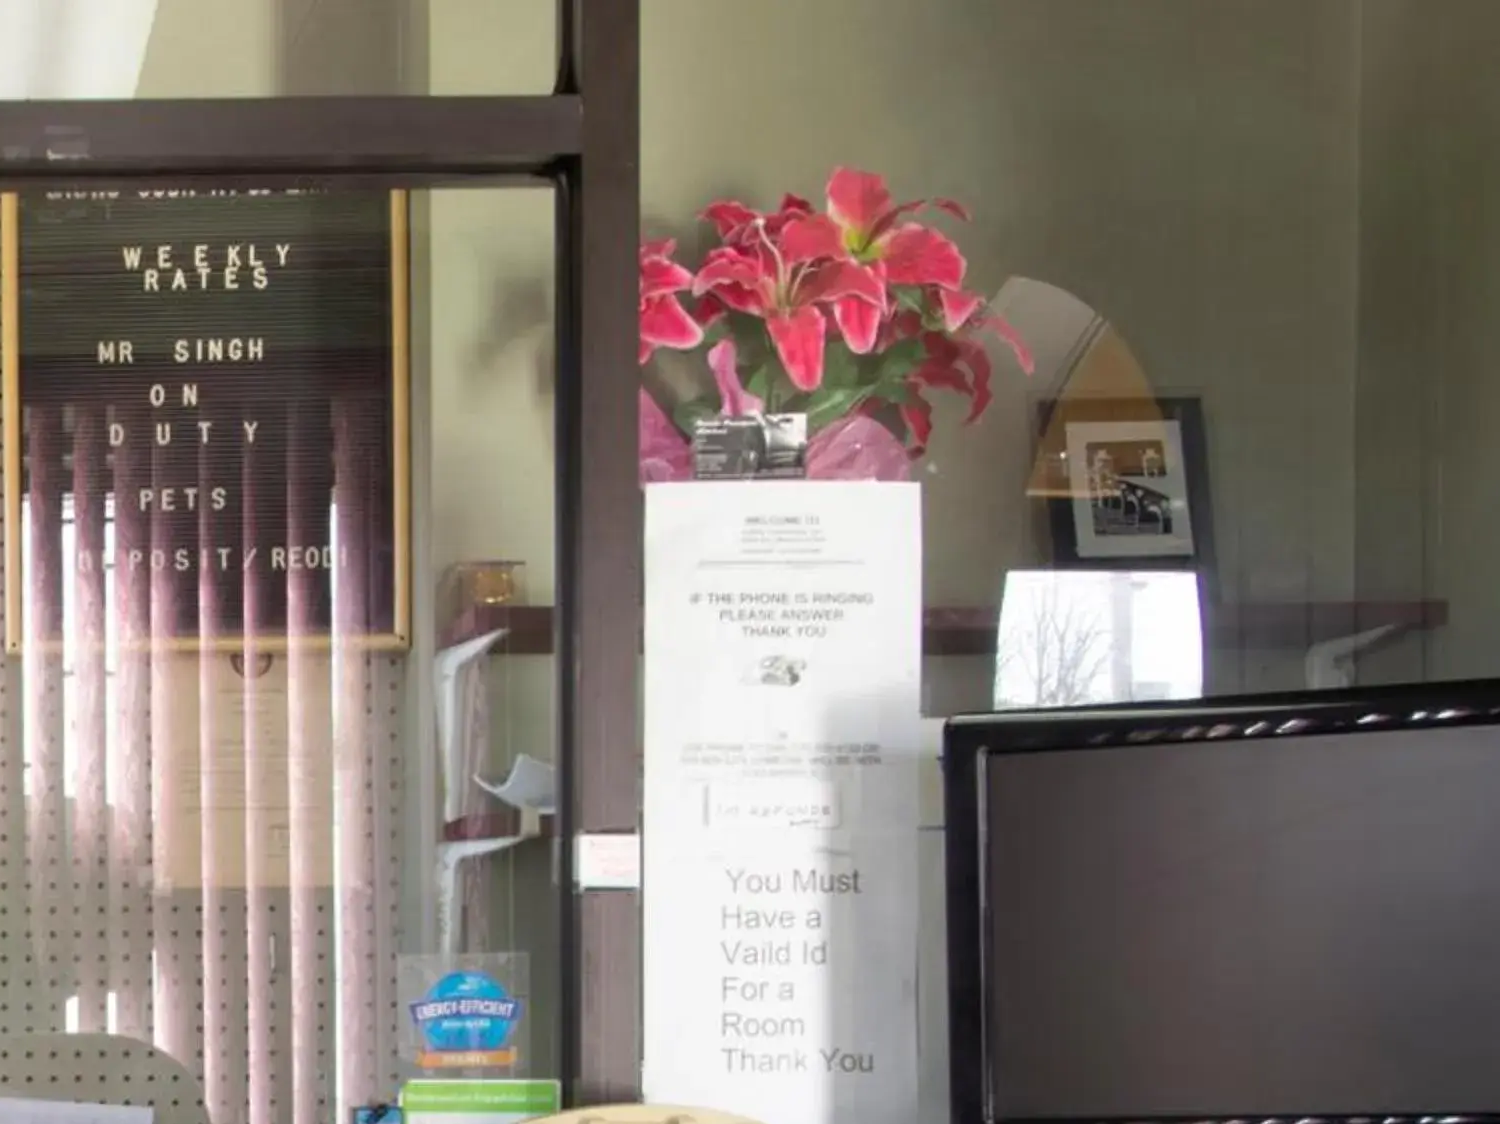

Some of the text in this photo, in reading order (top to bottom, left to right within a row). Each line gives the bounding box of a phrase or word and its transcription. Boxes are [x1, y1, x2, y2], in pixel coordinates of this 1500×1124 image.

[123, 244, 291, 271] WEEKLY
[144, 267, 269, 291] RATES
[98, 338, 265, 364] MR SINGH
[150, 384, 199, 407] ON
[109, 422, 259, 447] DUTY
[139, 488, 227, 512] PETS
[707, 592, 733, 605] THE
[740, 592, 789, 605] PHONE
[794, 592, 809, 605] IS
[812, 592, 874, 605] RINGING
[719, 609, 844, 622] PLEASE ANSWER
[742, 625, 827, 638] THANK YOU
[725, 868, 861, 894] You Must
[721, 905, 822, 929] Have a
[720, 941, 828, 966] Vaild Id
[721, 977, 795, 1001] For a
[721, 1013, 805, 1037] Room
[720, 1047, 875, 1073] Thank You
